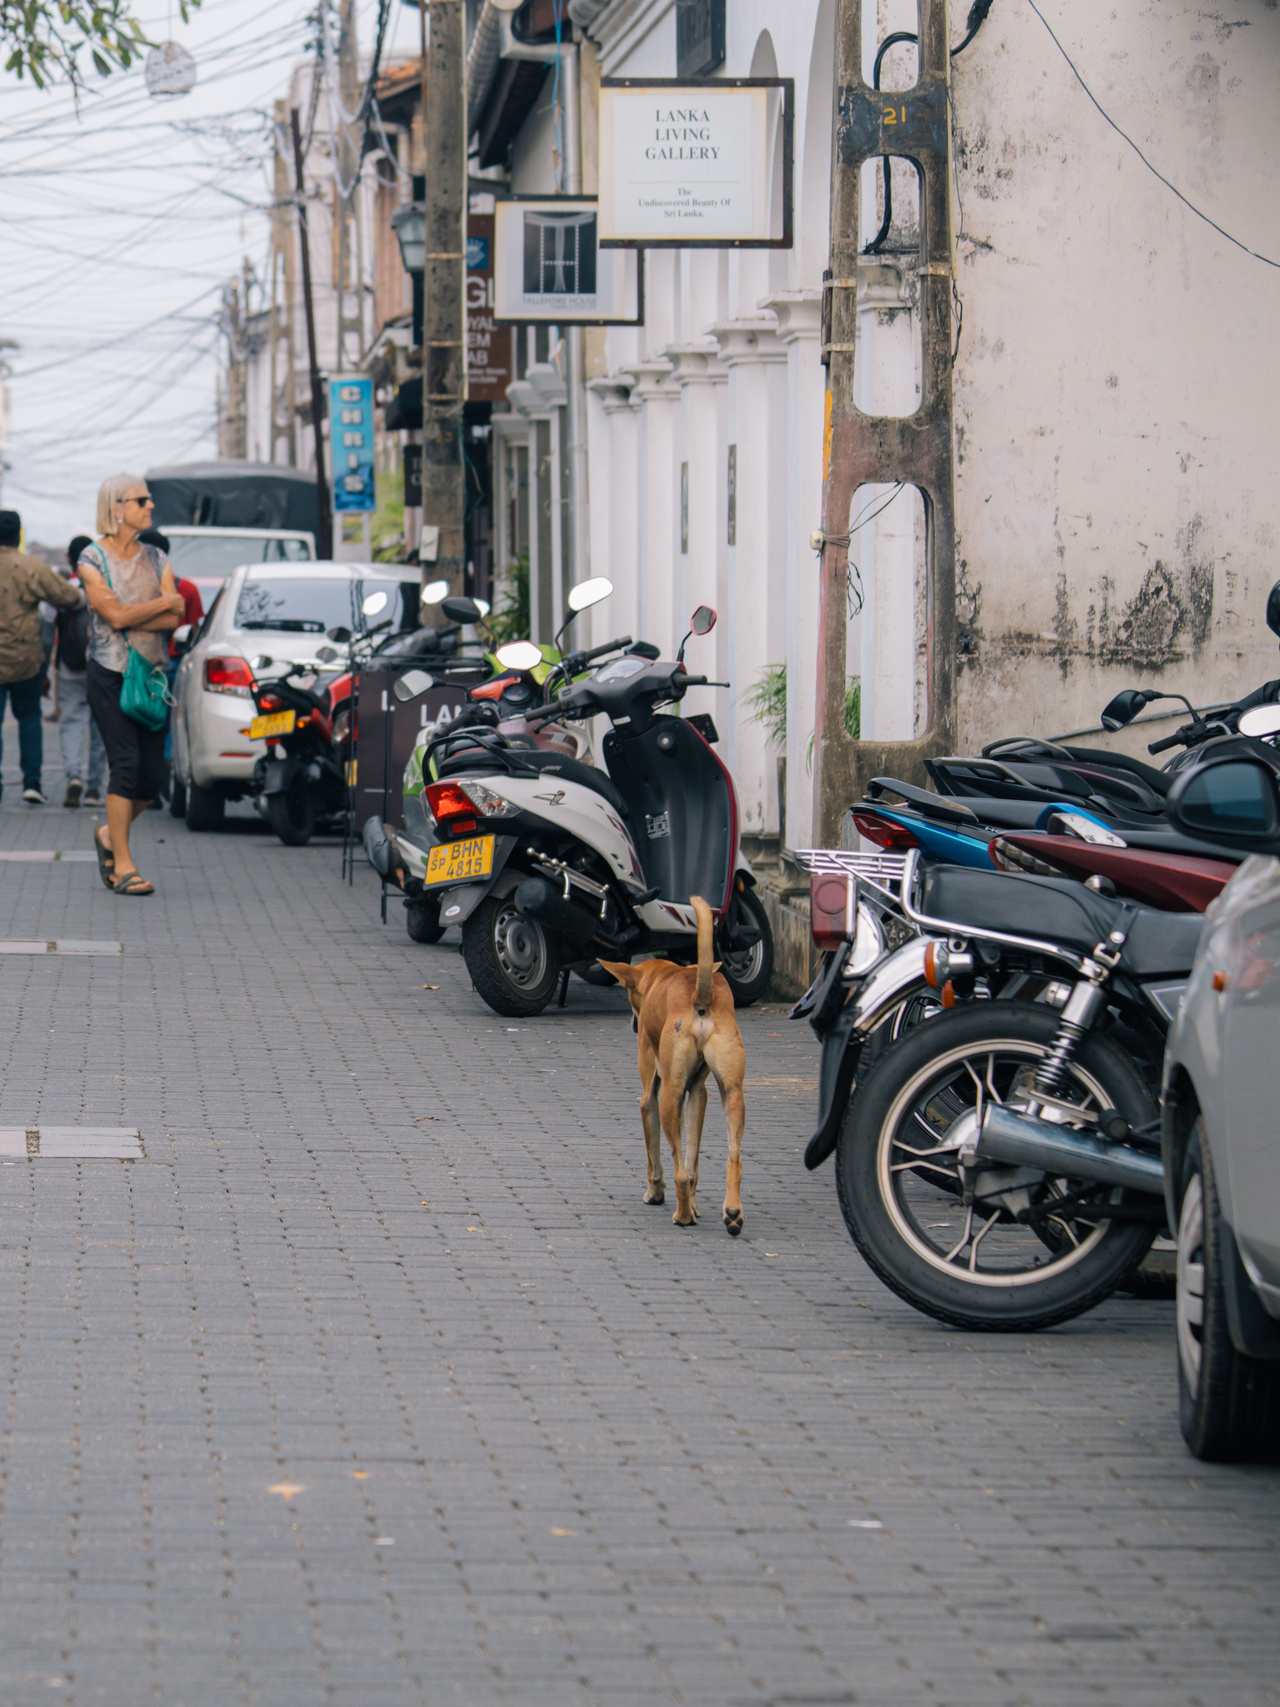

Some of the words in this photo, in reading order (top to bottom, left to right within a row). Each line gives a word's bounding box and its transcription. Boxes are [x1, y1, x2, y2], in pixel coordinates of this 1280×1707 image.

[655, 109, 711, 122] LANKA
[883, 105, 906, 125] 21
[655, 128, 711, 141] LIVING
[645, 146, 721, 160] GALLERY
[677, 188, 692, 196] The
[638, 198, 690, 207] Undiscovered
[692, 198, 718, 208] Beauty
[720, 198, 731, 207] Of
[663, 209, 676, 218] Sri
[678, 209, 705, 218] Lanka.
[466, 275, 495, 309] GL
[468, 332, 491, 348] EM
[468, 350, 488, 365] AB
[451, 839, 484, 860] BHN
[430, 857, 447, 871] SP
[447, 857, 483, 878] 4815
